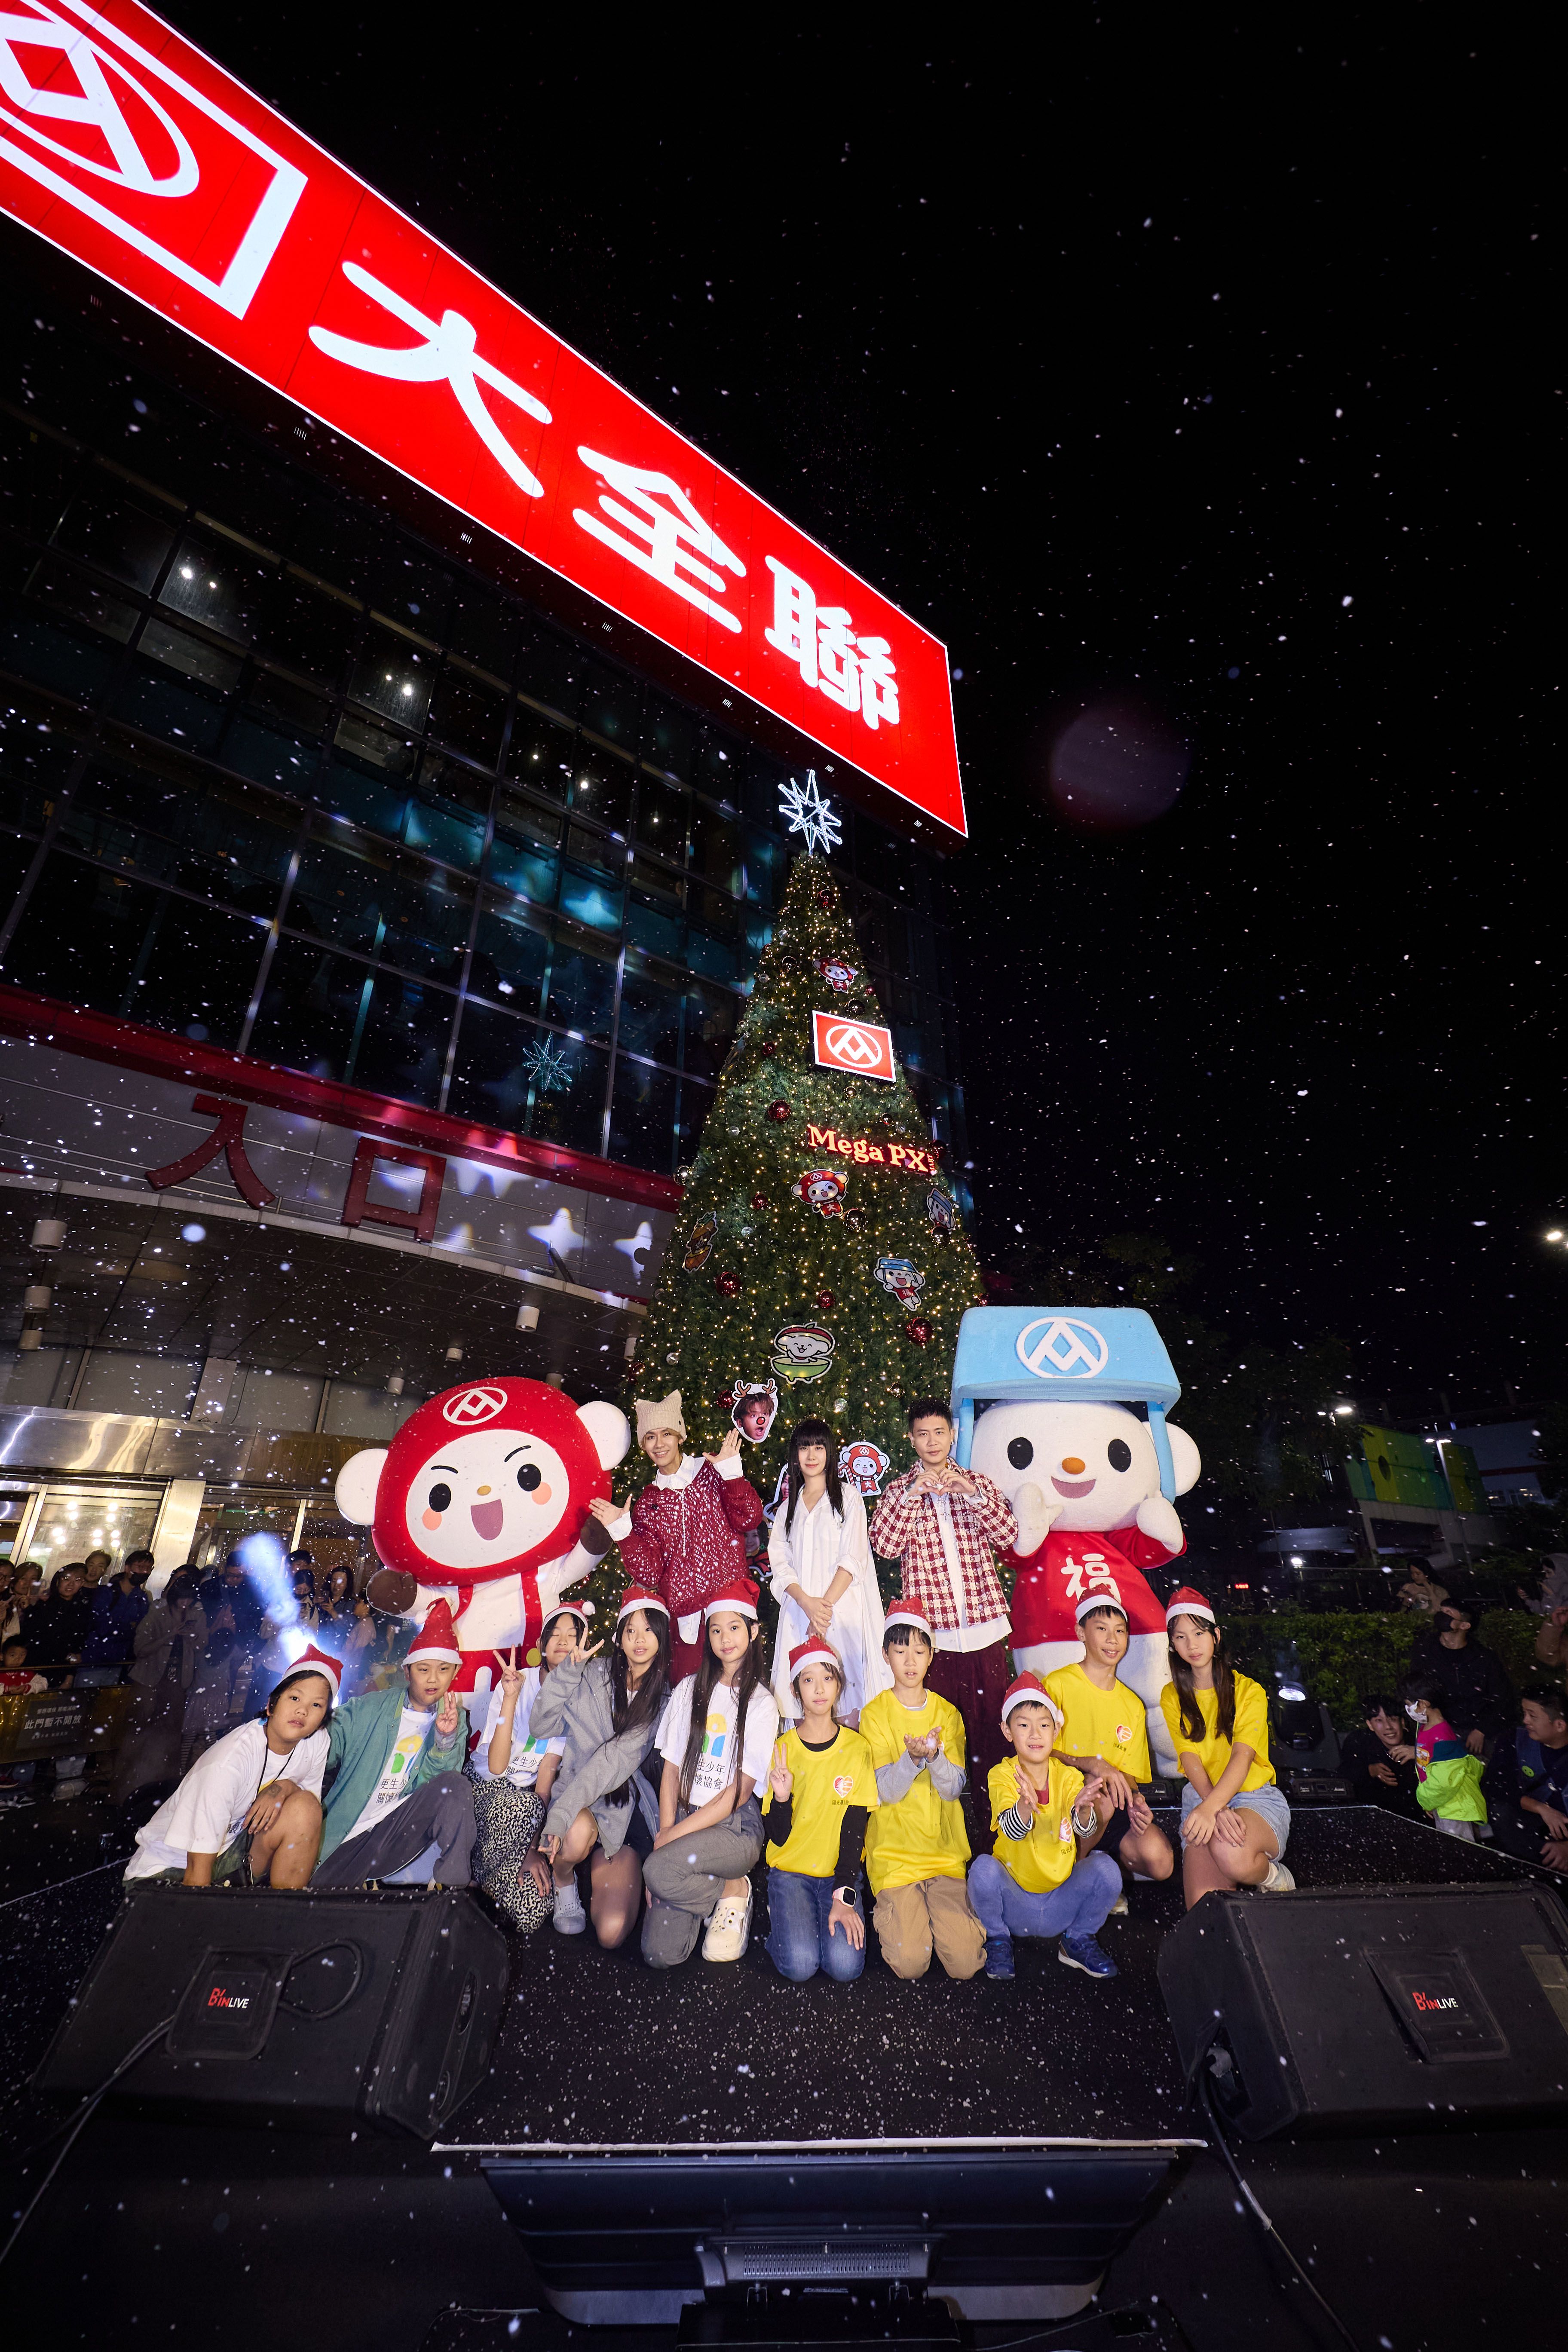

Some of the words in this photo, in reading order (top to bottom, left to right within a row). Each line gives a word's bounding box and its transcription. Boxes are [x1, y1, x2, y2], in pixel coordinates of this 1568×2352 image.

[309, 260, 900, 730] 大全聯
[807, 1125, 885, 1163] Mega
[888, 1143, 929, 1172] PX
[144, 1093, 447, 1244] 入口
[1060, 1553, 1121, 1605] 福
[694, 1773, 723, 1790] 懷協會
[696, 1759, 726, 1775] 生少年
[376, 1792, 400, 1804] 關懷
[380, 1778, 407, 1790] 更生少
